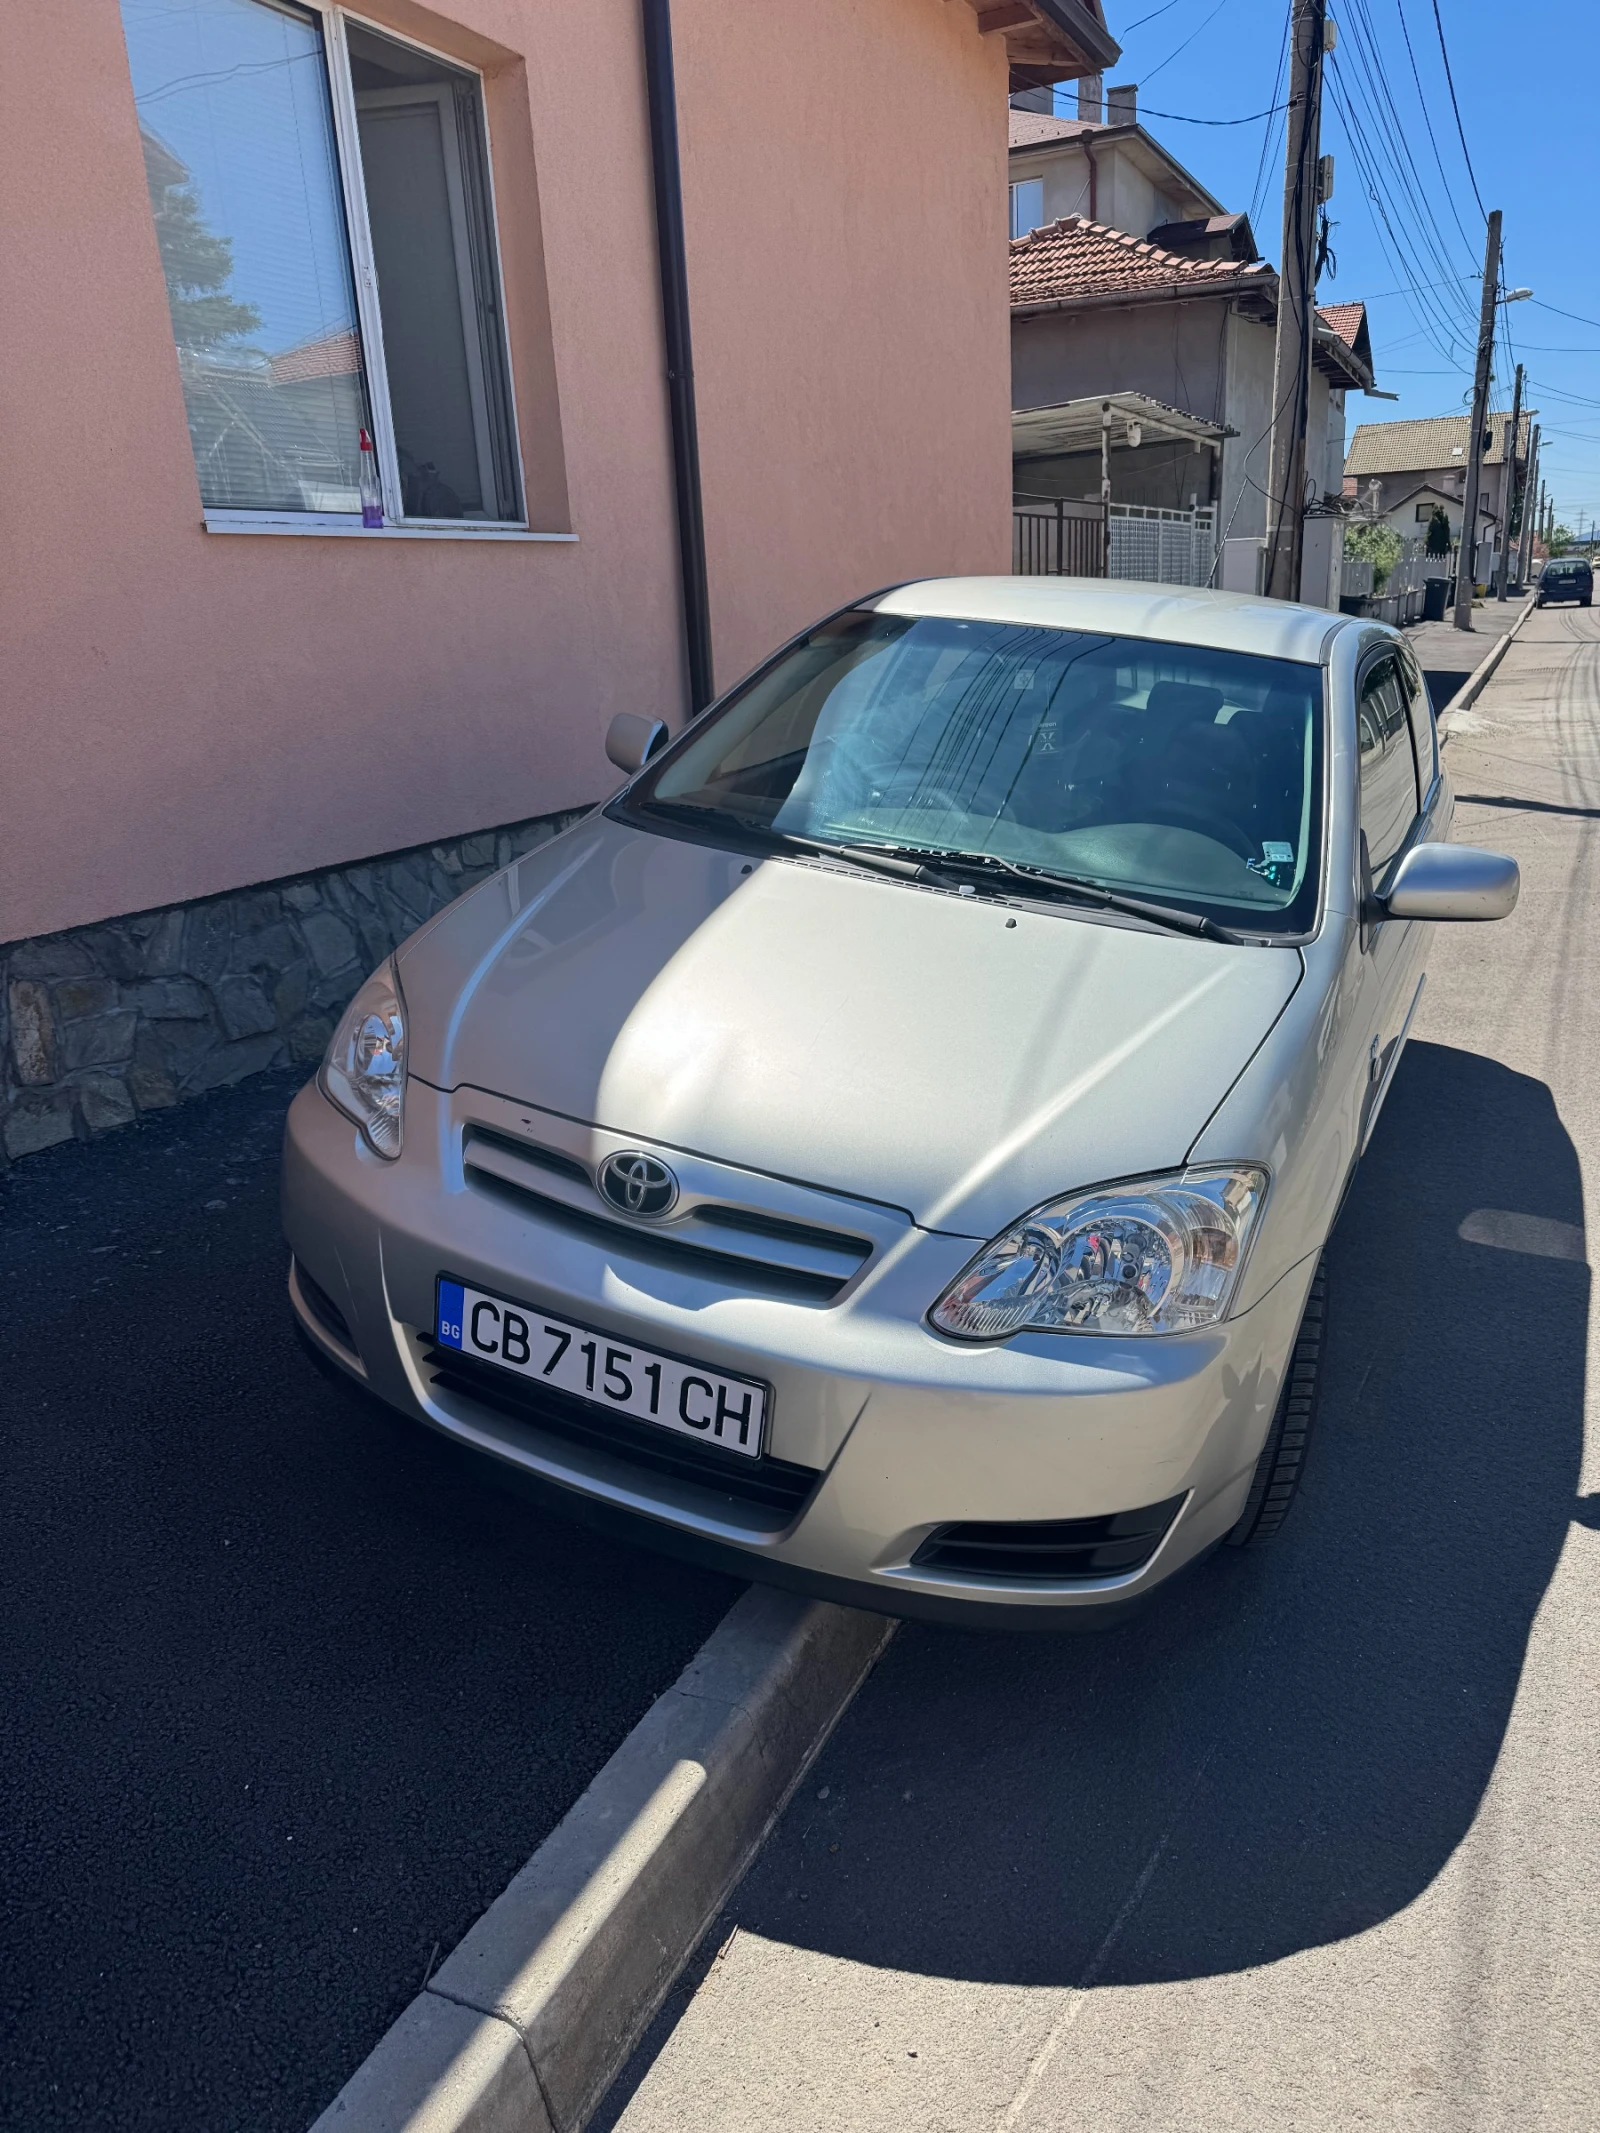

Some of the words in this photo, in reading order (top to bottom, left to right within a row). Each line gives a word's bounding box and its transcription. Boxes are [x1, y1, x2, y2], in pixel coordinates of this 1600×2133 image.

[441, 1320, 460, 1339] BG
[470, 1301, 531, 1365] CB
[542, 1325, 662, 1415] 7151
[678, 1376, 752, 1446] CH
